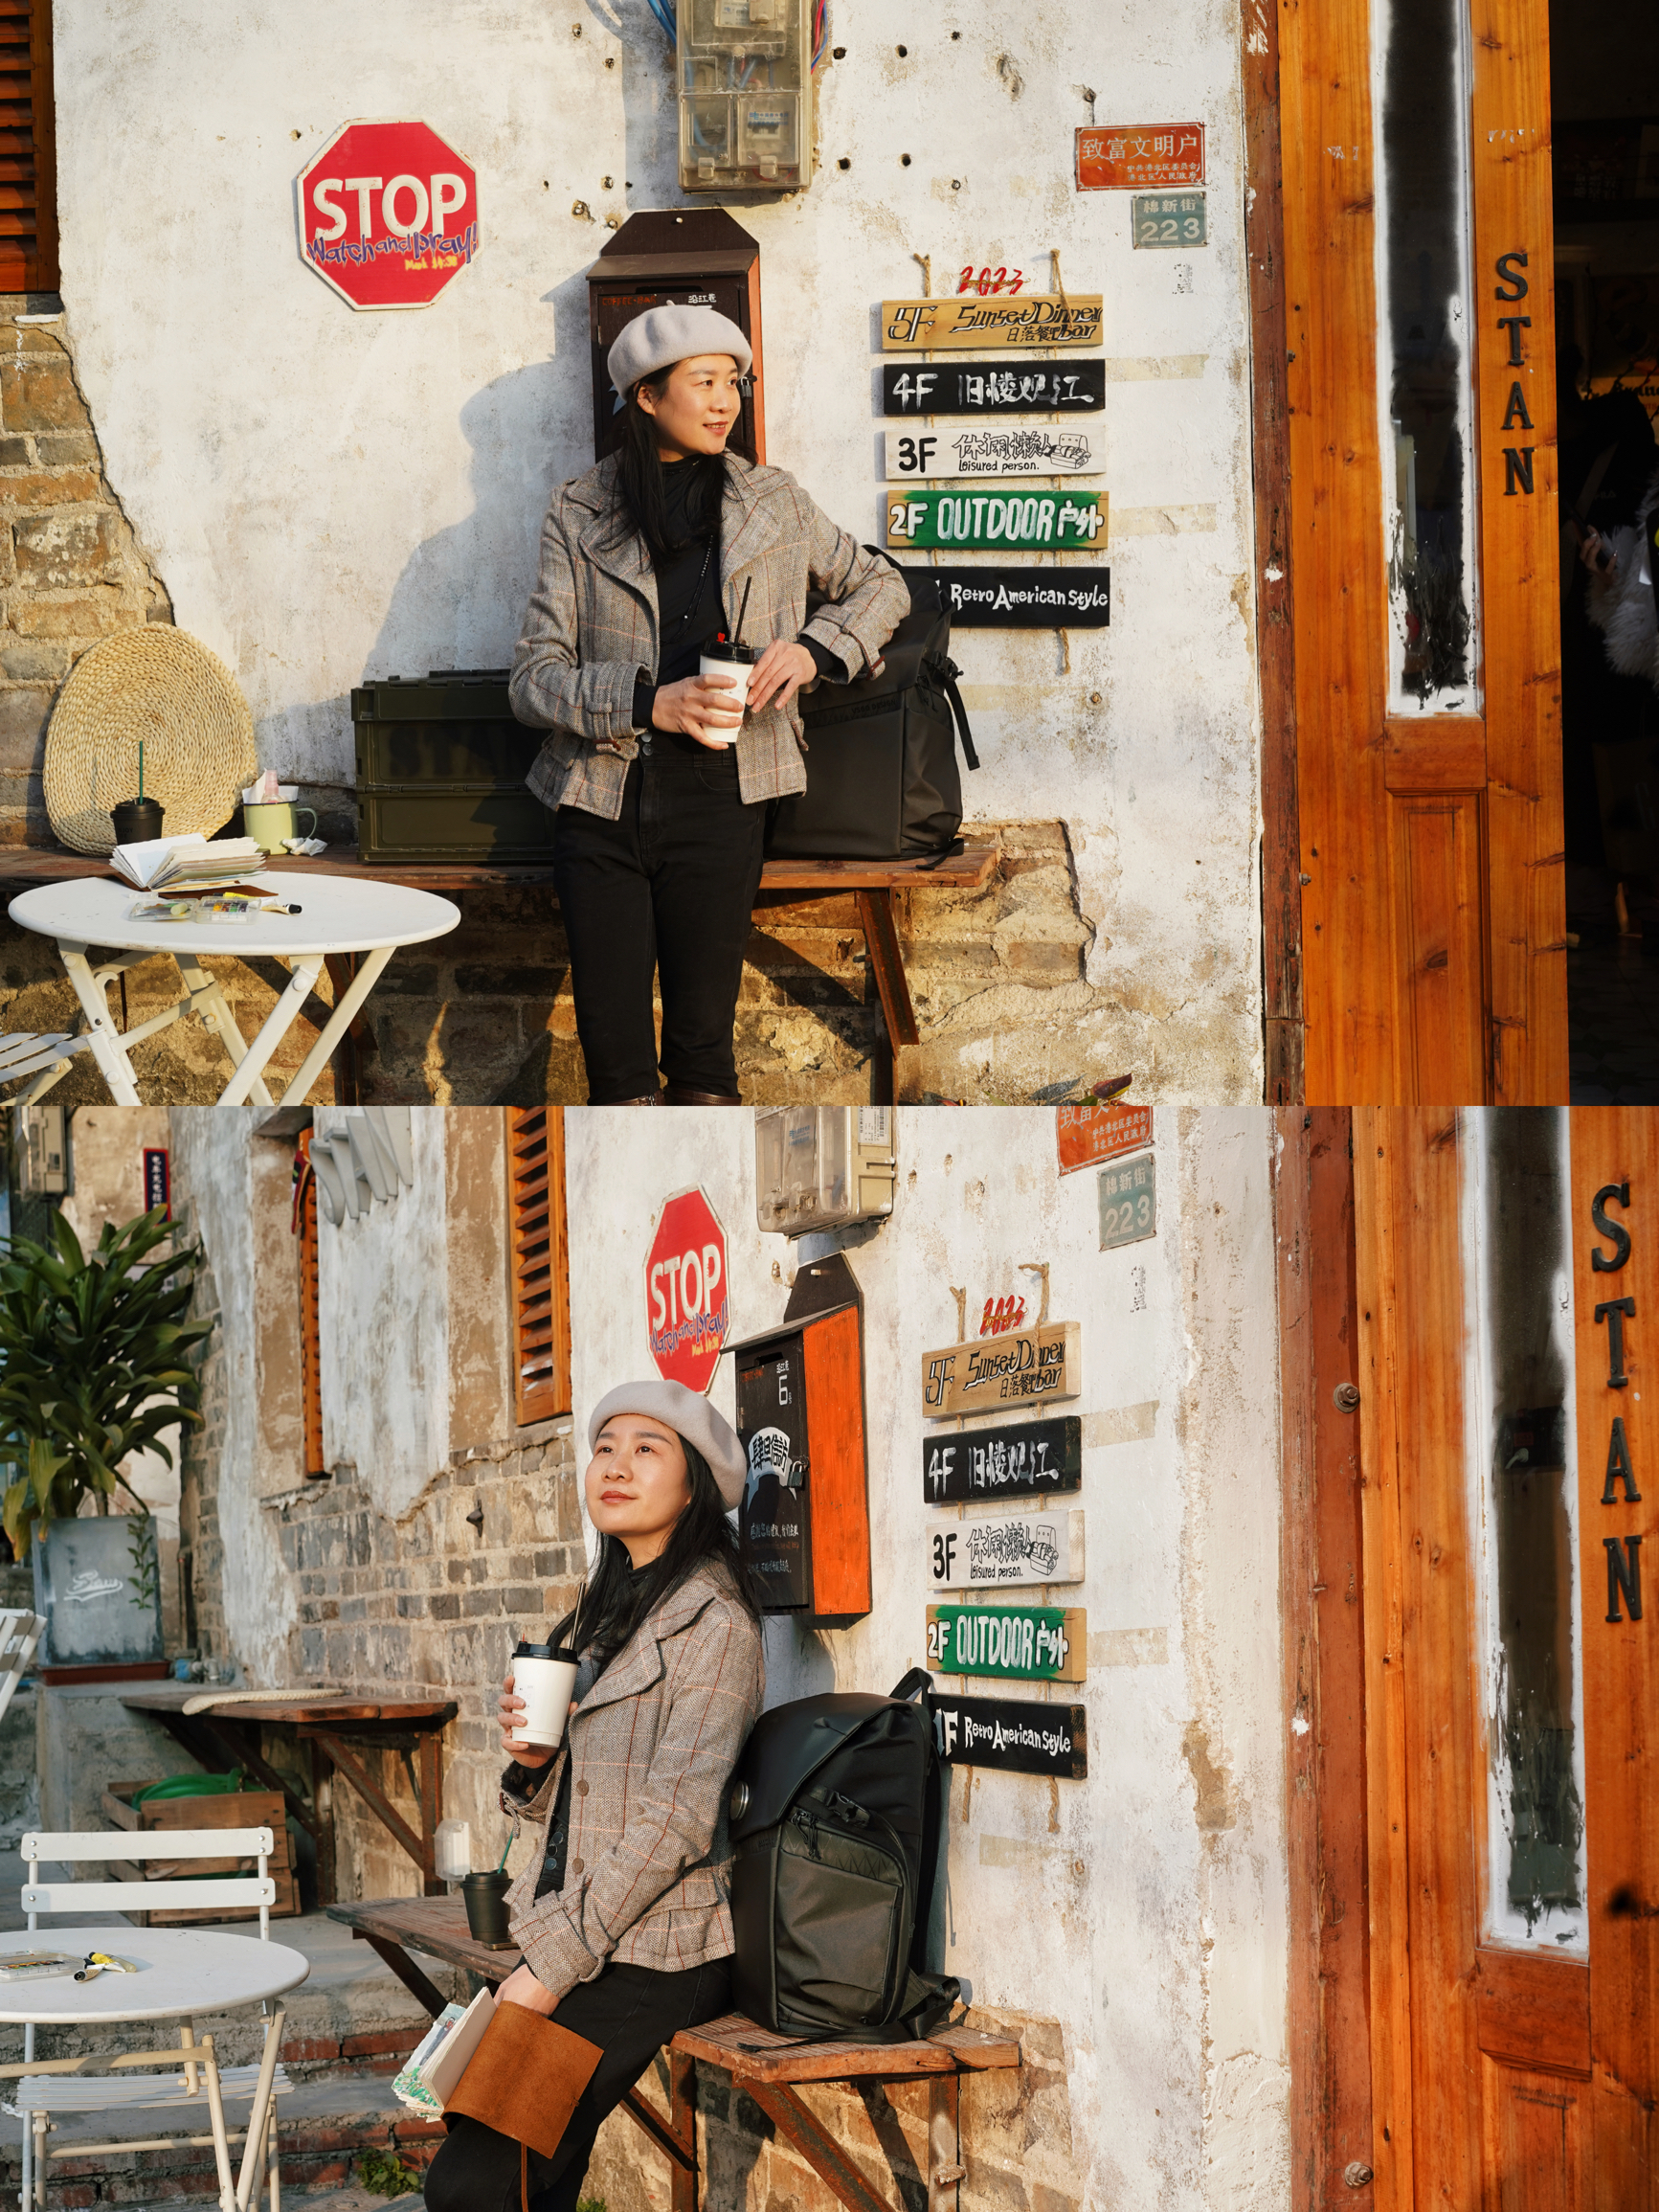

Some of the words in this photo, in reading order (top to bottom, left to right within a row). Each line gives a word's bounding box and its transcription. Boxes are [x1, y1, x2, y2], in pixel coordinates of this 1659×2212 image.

[1082, 134, 1197, 160] 致富文明户
[313, 173, 466, 240] STOP
[306, 234, 375, 265] Watch
[375, 234, 412, 254] and
[1140, 217, 1200, 242] 223
[958, 265, 1023, 296] 2023
[888, 305, 937, 342] 5F
[949, 305, 1037, 333] Sunset
[1034, 302, 1103, 324] Dinner
[1057, 324, 1097, 341] bar
[892, 372, 938, 412] 4F
[1495, 252, 1535, 496] STAN
[899, 438, 937, 472] 3F
[1001, 461, 1040, 473] person.
[889, 502, 930, 538] 2F
[937, 498, 1055, 541] OUTDOOR
[1056, 499, 1105, 540] 户外
[951, 583, 994, 610] Retro
[992, 584, 1065, 610] American
[1068, 584, 1108, 610] Style
[1105, 1195, 1150, 1240] 223
[650, 1244, 721, 1332] STOP
[979, 1295, 1025, 1336] 2023
[925, 1356, 956, 1407] 5F
[962, 1350, 1018, 1390] Sunset
[1034, 1367, 1062, 1393] bar
[1591, 1183, 1643, 1623] STAN
[928, 1447, 956, 1501] 4F
[933, 1533, 957, 1581] 3F
[927, 1619, 952, 1662] 2F
[956, 1614, 1034, 1670] OUTDOOR
[1035, 1617, 1070, 1670] 户外
[964, 1716, 993, 1748] Retro
[992, 1720, 1042, 1751] American
[1042, 1726, 1071, 1756] Style
